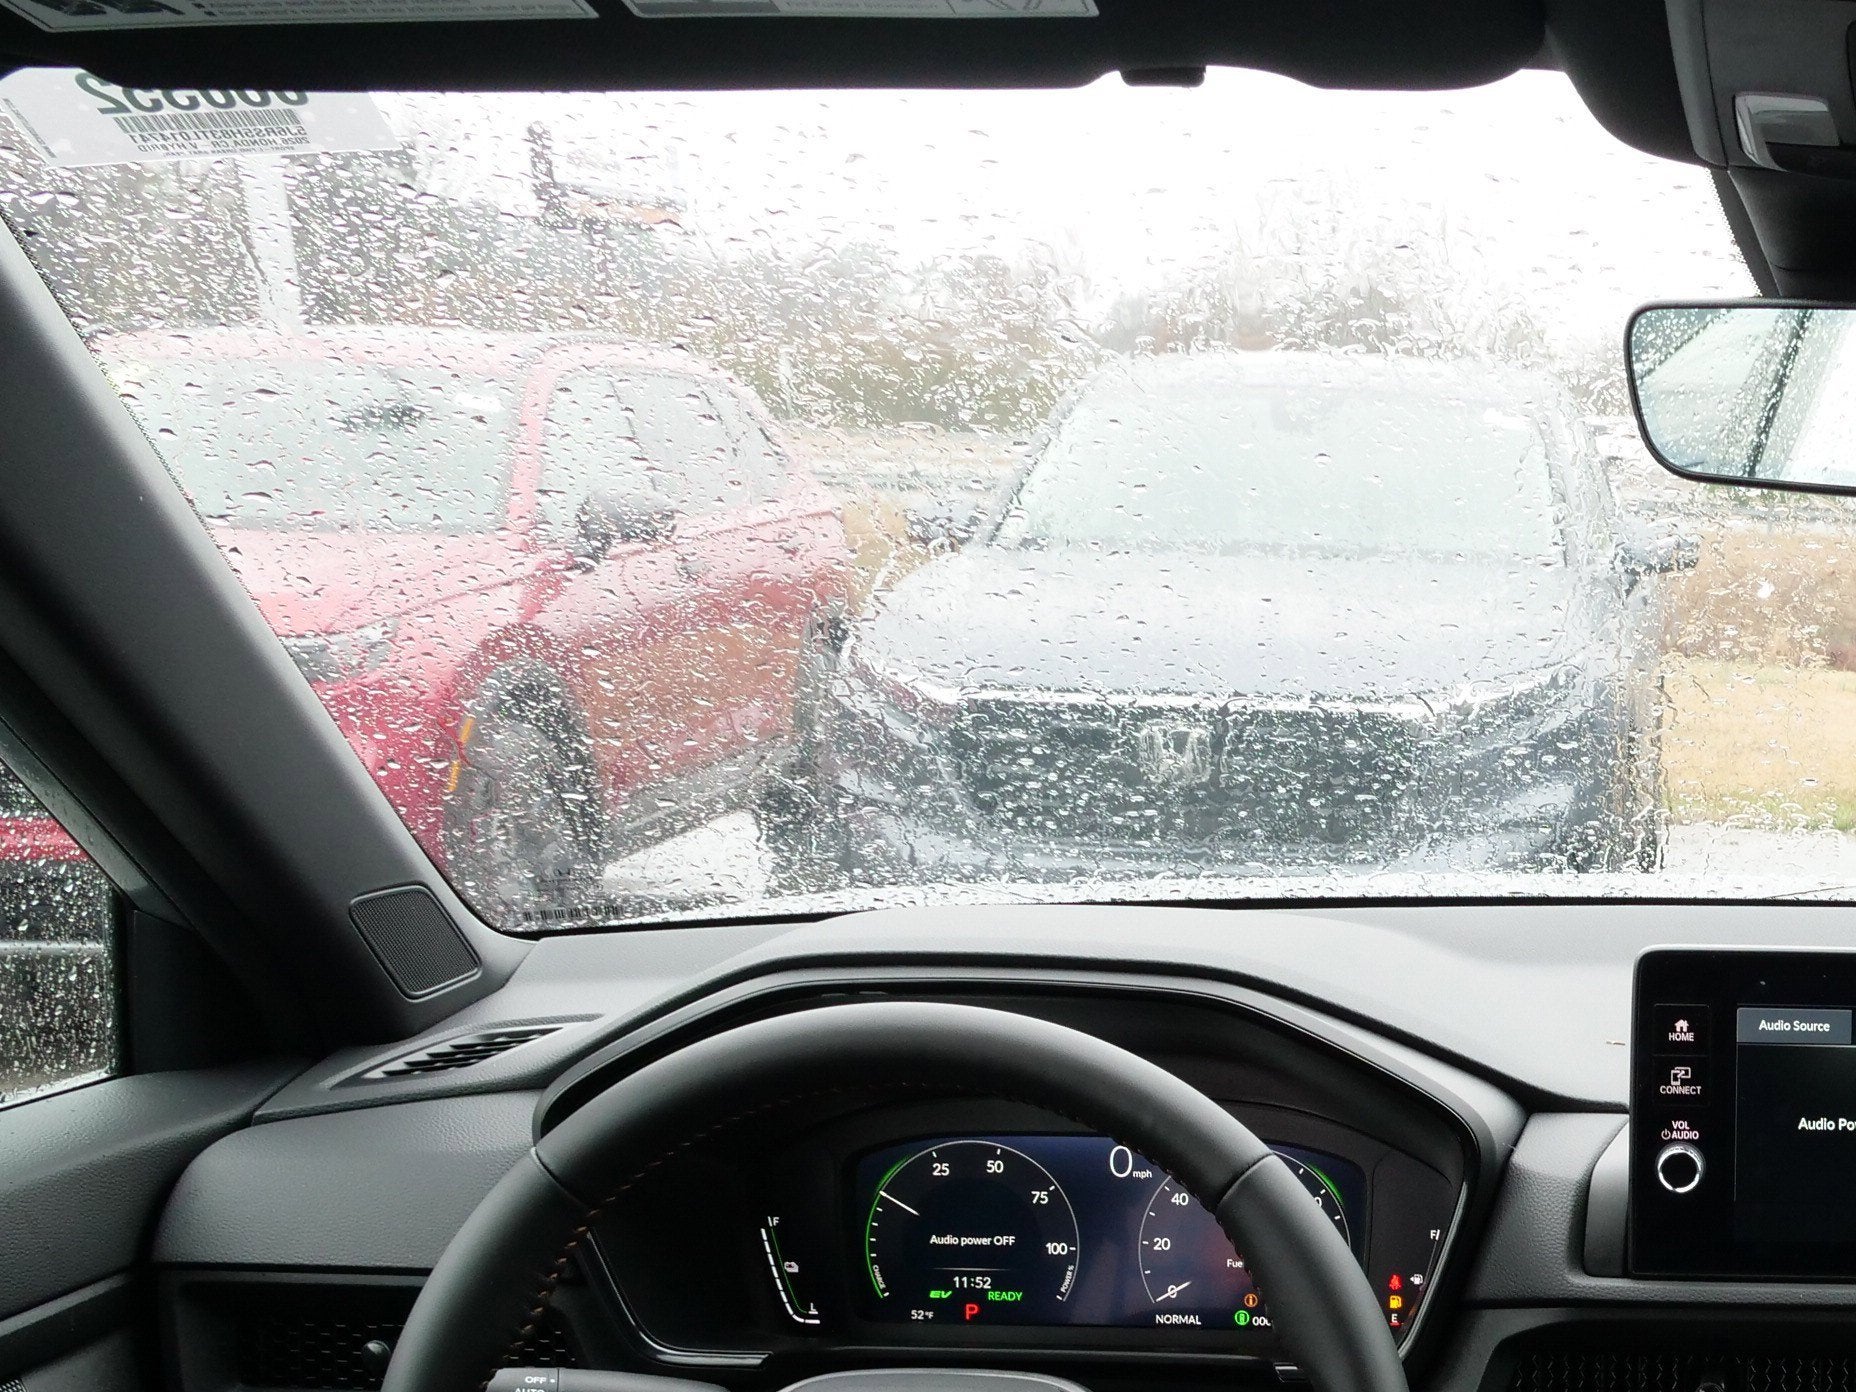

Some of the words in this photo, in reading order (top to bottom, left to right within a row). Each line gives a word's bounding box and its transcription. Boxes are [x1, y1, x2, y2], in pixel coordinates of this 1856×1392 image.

[1759, 1020, 1791, 1032] Audio
[1792, 1020, 1830, 1032] Source
[1668, 1032, 1694, 1042] HOME
[1660, 1086, 1702, 1095] CONNECT
[1672, 1120, 1690, 1130] VOL
[1798, 1118, 1836, 1131] Audio
[1672, 1130, 1700, 1140] AUDIO
[986, 1160, 1004, 1173] 50
[1109, 1145, 1133, 1178] 0
[1132, 1170, 1152, 1180] mph
[932, 1163, 950, 1176] 25
[1031, 1190, 1049, 1204] 75
[1170, 1192, 1189, 1206] 40
[773, 1217, 780, 1226] F
[930, 1234, 958, 1245] Audio
[960, 1236, 992, 1247] power
[994, 1235, 1016, 1246] OFF
[1430, 1230, 1436, 1240] F
[1046, 1242, 1068, 1256] 100
[1152, 1238, 1171, 1251] 20
[1226, 1259, 1244, 1268] Fue
[952, 1276, 992, 1289] 11:52
[930, 1290, 952, 1299] EV
[988, 1291, 1023, 1301] READY
[965, 1303, 980, 1320] P
[1156, 1314, 1202, 1326] NORMAL
[1391, 1314, 1398, 1323] E
